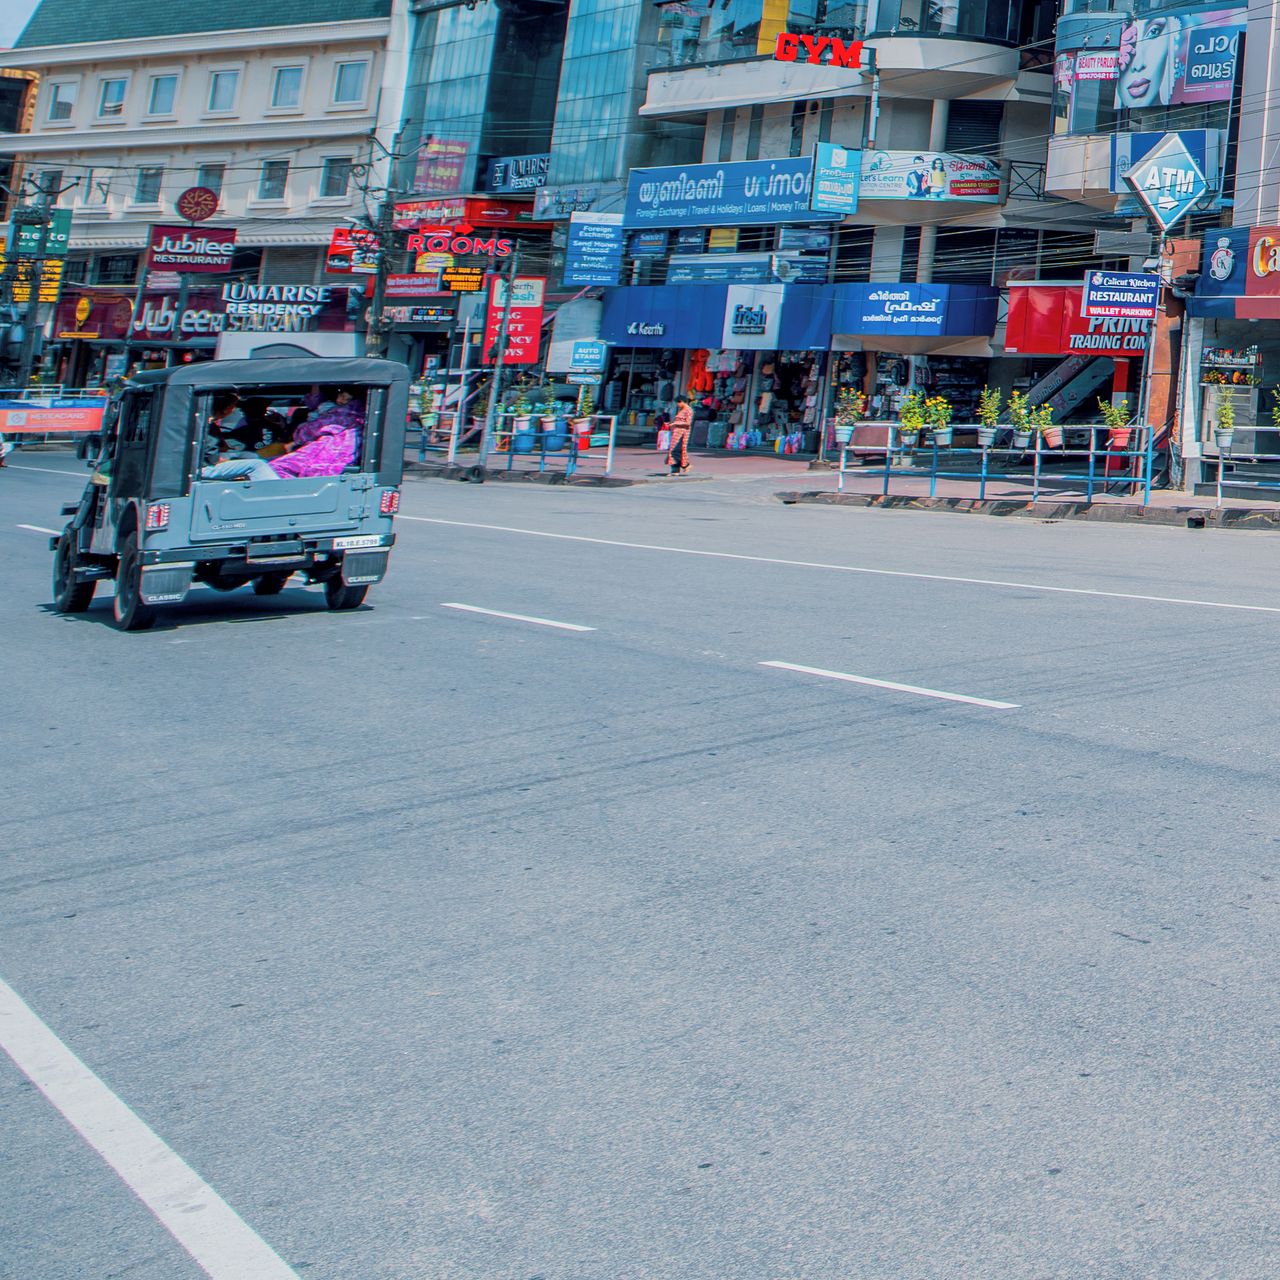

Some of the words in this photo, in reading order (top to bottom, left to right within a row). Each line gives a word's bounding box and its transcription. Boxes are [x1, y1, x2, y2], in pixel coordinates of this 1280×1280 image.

[775, 32, 864, 68] GYM
[1144, 165, 1195, 194] ATM
[636, 207, 658, 218] Foreign
[658, 206, 687, 217] Exchange
[692, 205, 709, 215] Travel
[710, 205, 715, 213] &
[716, 203, 742, 216] Holidays
[747, 203, 766, 213] Loans
[771, 202, 792, 213] Money
[579, 231, 615, 239] Exchange
[583, 225, 612, 233] Foreign
[20, 232, 67, 241] meta
[152, 233, 235, 255] Jubilee
[407, 234, 512, 257] ROOMS
[153, 253, 230, 266] RESTAURANT
[1103, 277, 1128, 285] Calicut
[1129, 278, 1156, 288] Kitchen
[221, 282, 332, 303] LUMARISE
[1089, 291, 1154, 303] RESTAURANT
[133, 296, 210, 333] Jubiee
[226, 303, 322, 316] RESIDENCY
[1089, 307, 1120, 315] WALLET
[638, 323, 664, 336] Keerthi
[1070, 334, 1122, 350] TRADING
